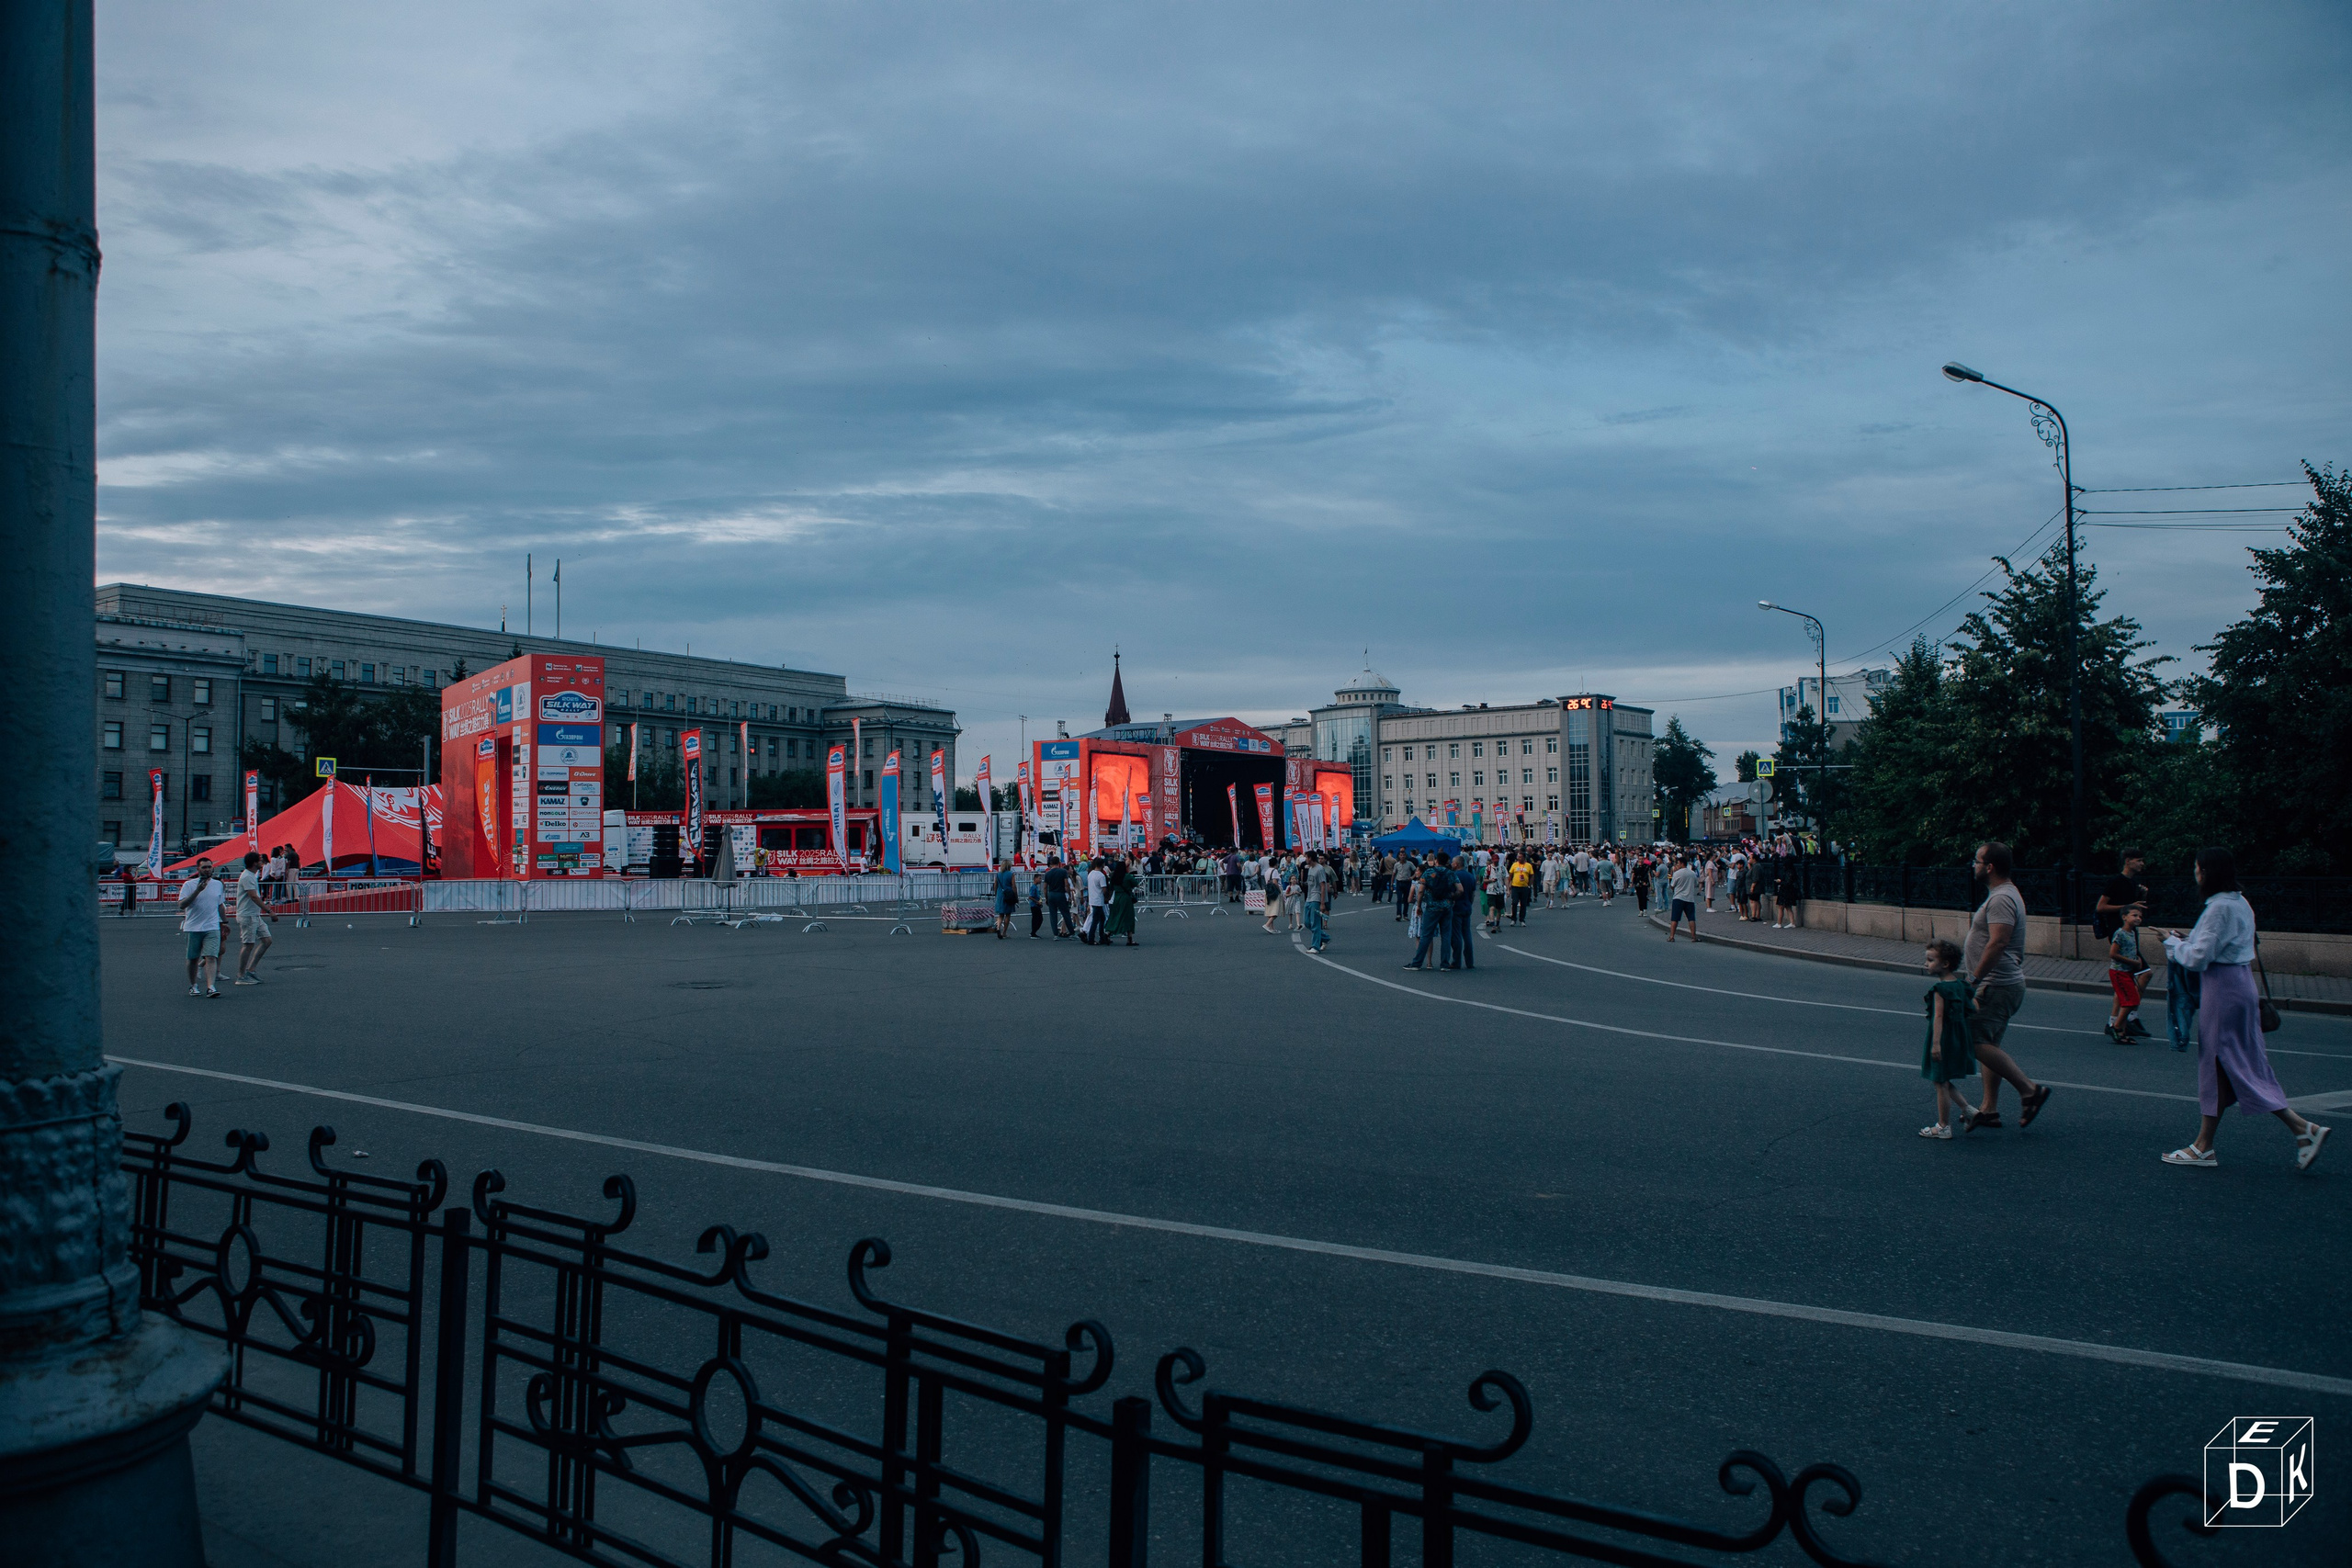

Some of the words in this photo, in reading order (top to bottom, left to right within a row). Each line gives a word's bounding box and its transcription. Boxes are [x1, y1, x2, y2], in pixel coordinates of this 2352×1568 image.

[449, 704, 461, 724] SILK
[471, 694, 490, 716] RALLY
[1567, 699, 1579, 710] 26
[449, 722, 460, 740] WAY
[1164, 777, 1178, 787] SILK
[1164, 786, 1178, 795] WAY
[1164, 795, 1178, 804] RALLY
